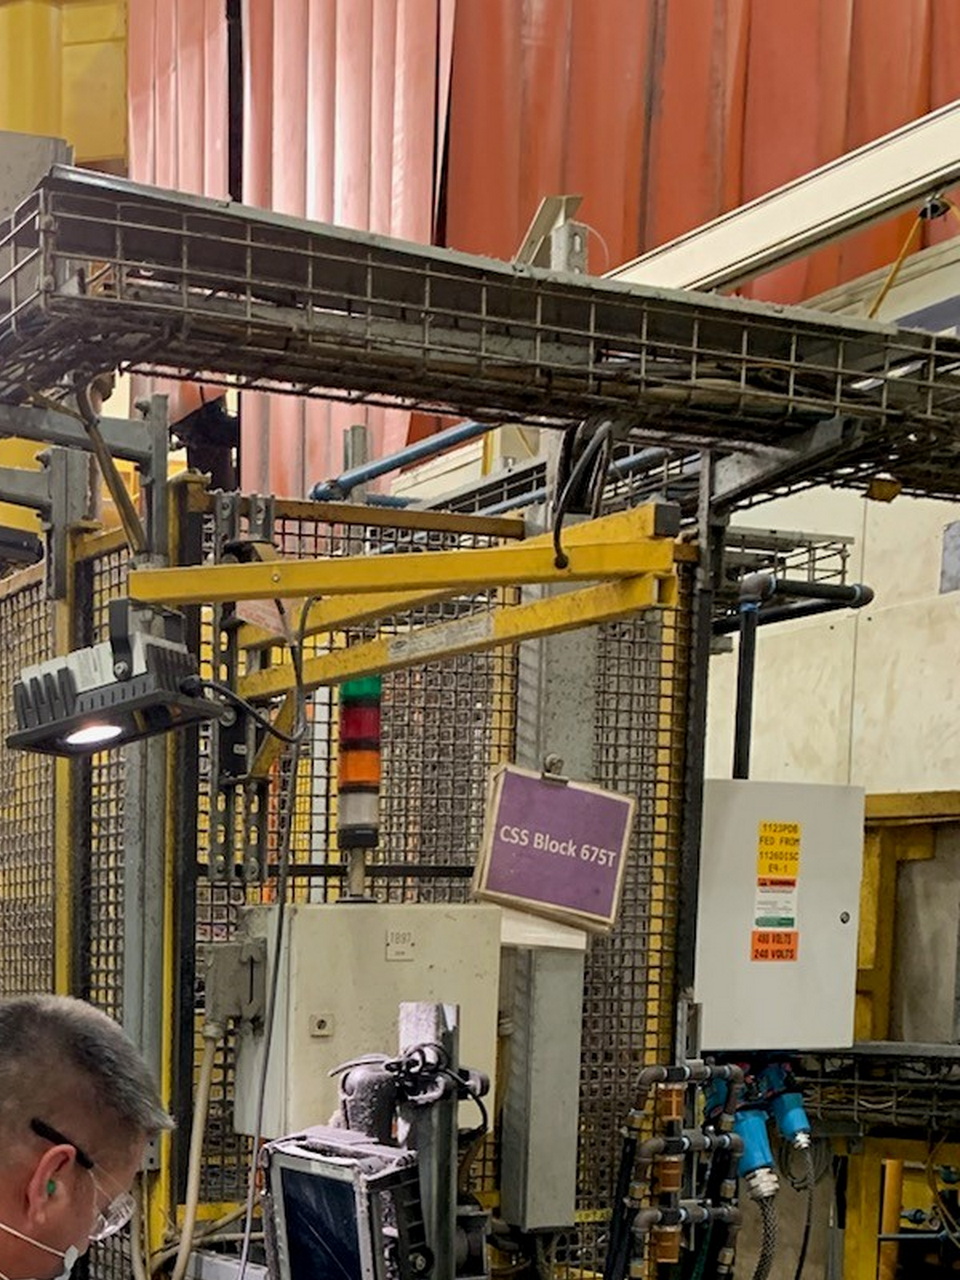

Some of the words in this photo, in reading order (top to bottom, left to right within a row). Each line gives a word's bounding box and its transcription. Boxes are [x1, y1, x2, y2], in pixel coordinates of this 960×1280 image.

[500, 825, 529, 846] CSS
[533, 832, 578, 857] Block
[580, 844, 617, 868] 675T
[771, 949, 795, 960] VOLTS
